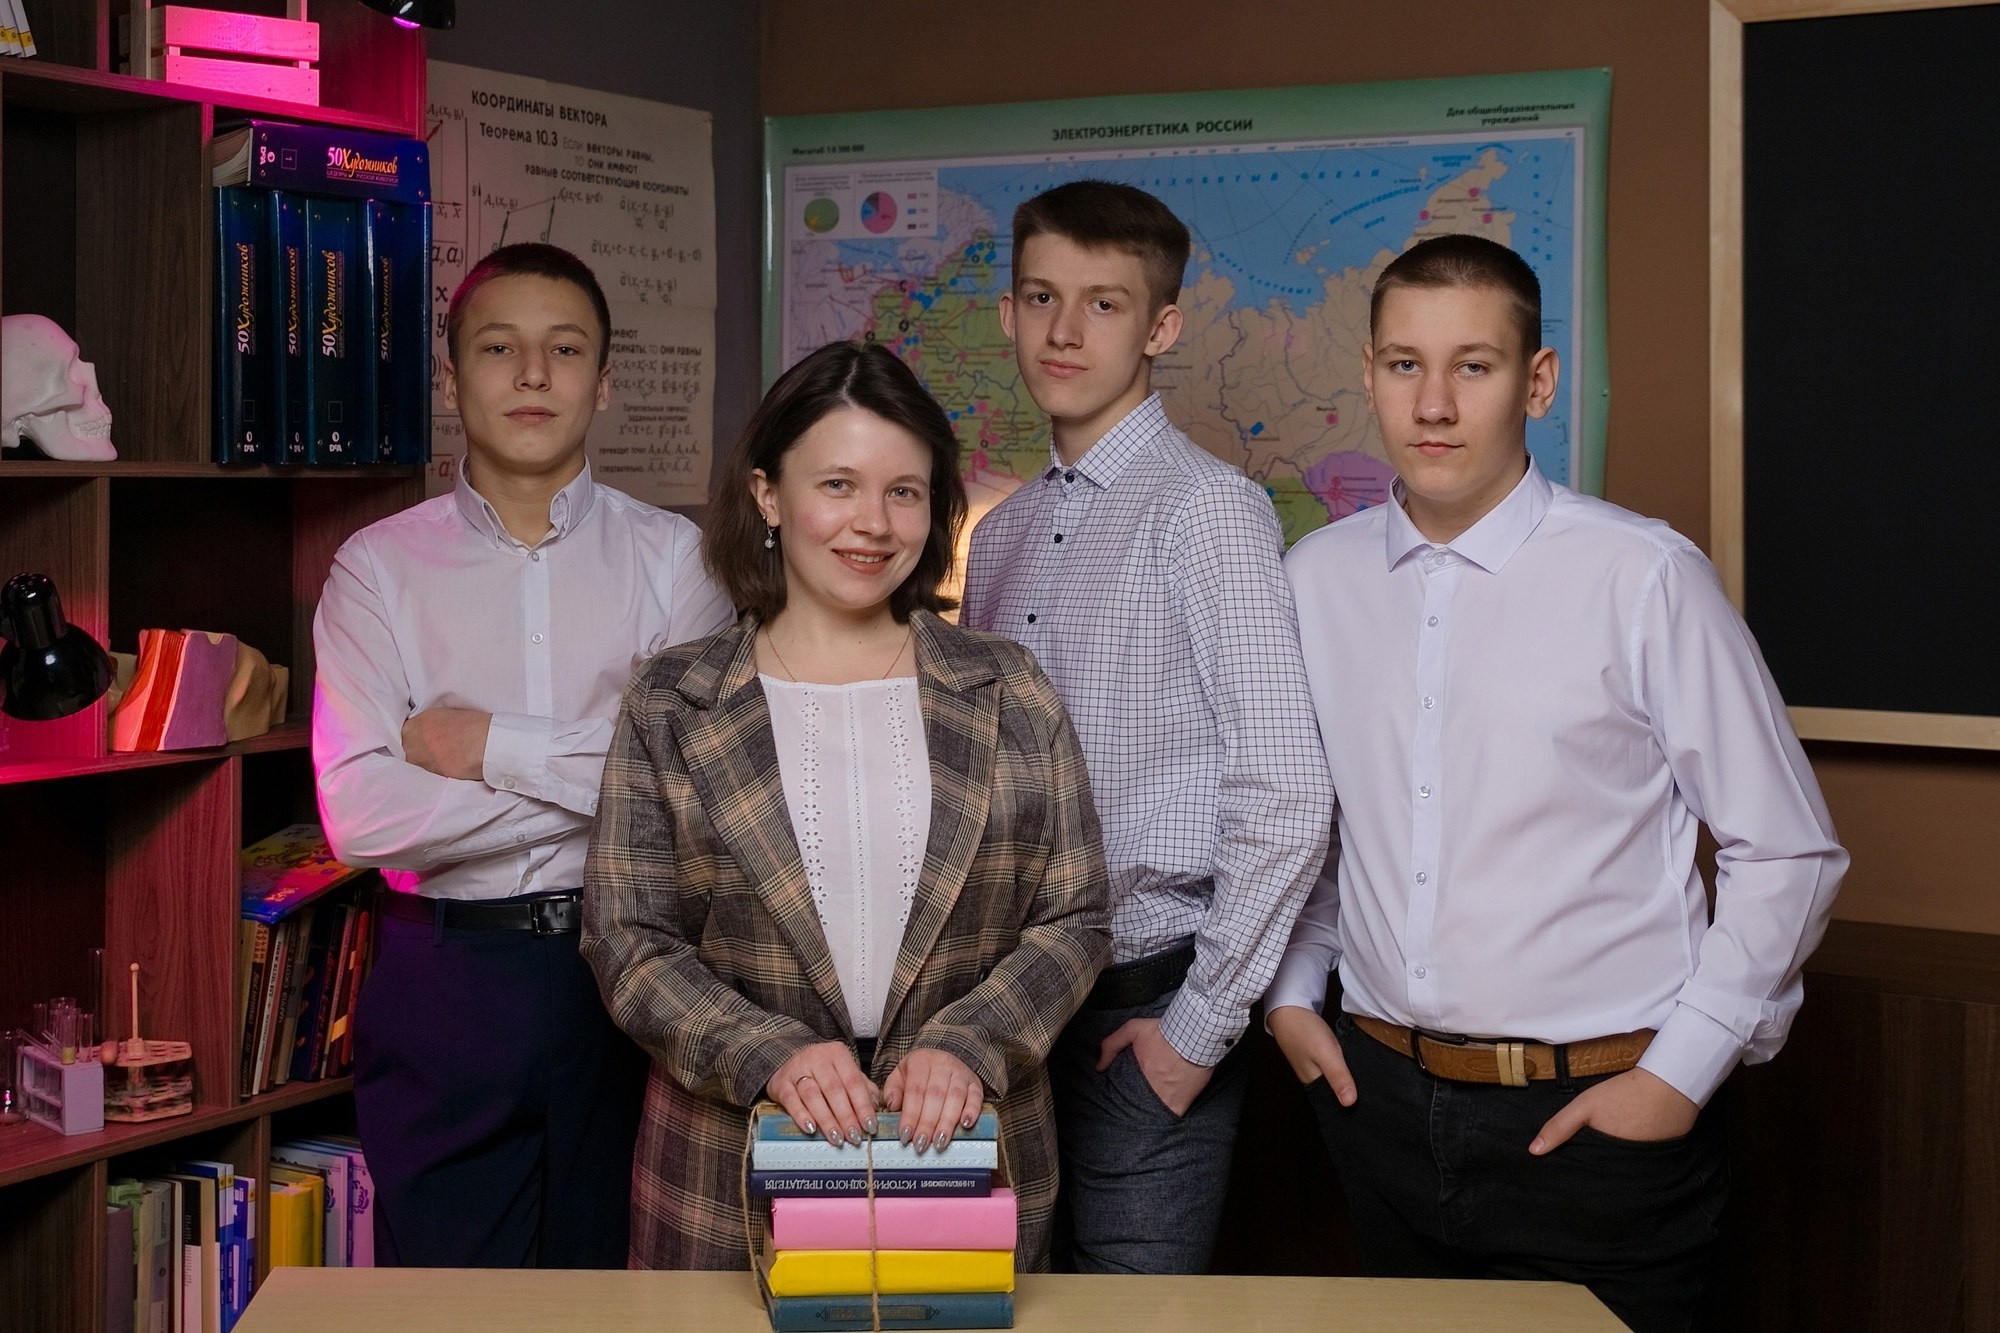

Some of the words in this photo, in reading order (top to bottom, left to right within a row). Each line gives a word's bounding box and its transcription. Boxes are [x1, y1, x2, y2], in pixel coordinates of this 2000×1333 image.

[471, 90, 555, 118] КООРДИНАТЫ
[560, 104, 608, 128] ВЕКТОРА
[1446, 107, 1465, 118] Для
[1481, 113, 1540, 127] учреждений
[1052, 123, 1189, 141] ЭЛЕКТРОЭНЕРГЕТИКА
[1196, 119, 1253, 134] РОССИИ
[480, 122, 532, 144] Теорема
[536, 129, 558, 147] 10.3
[586, 142, 623, 158] векторы
[588, 158, 605, 170] они
[607, 160, 638, 175] имеют
[525, 164, 558, 179] равные
[561, 168, 640, 191] соответствующие
[765, 1179, 823, 1190] ПРЕДАТЕЛЯ
